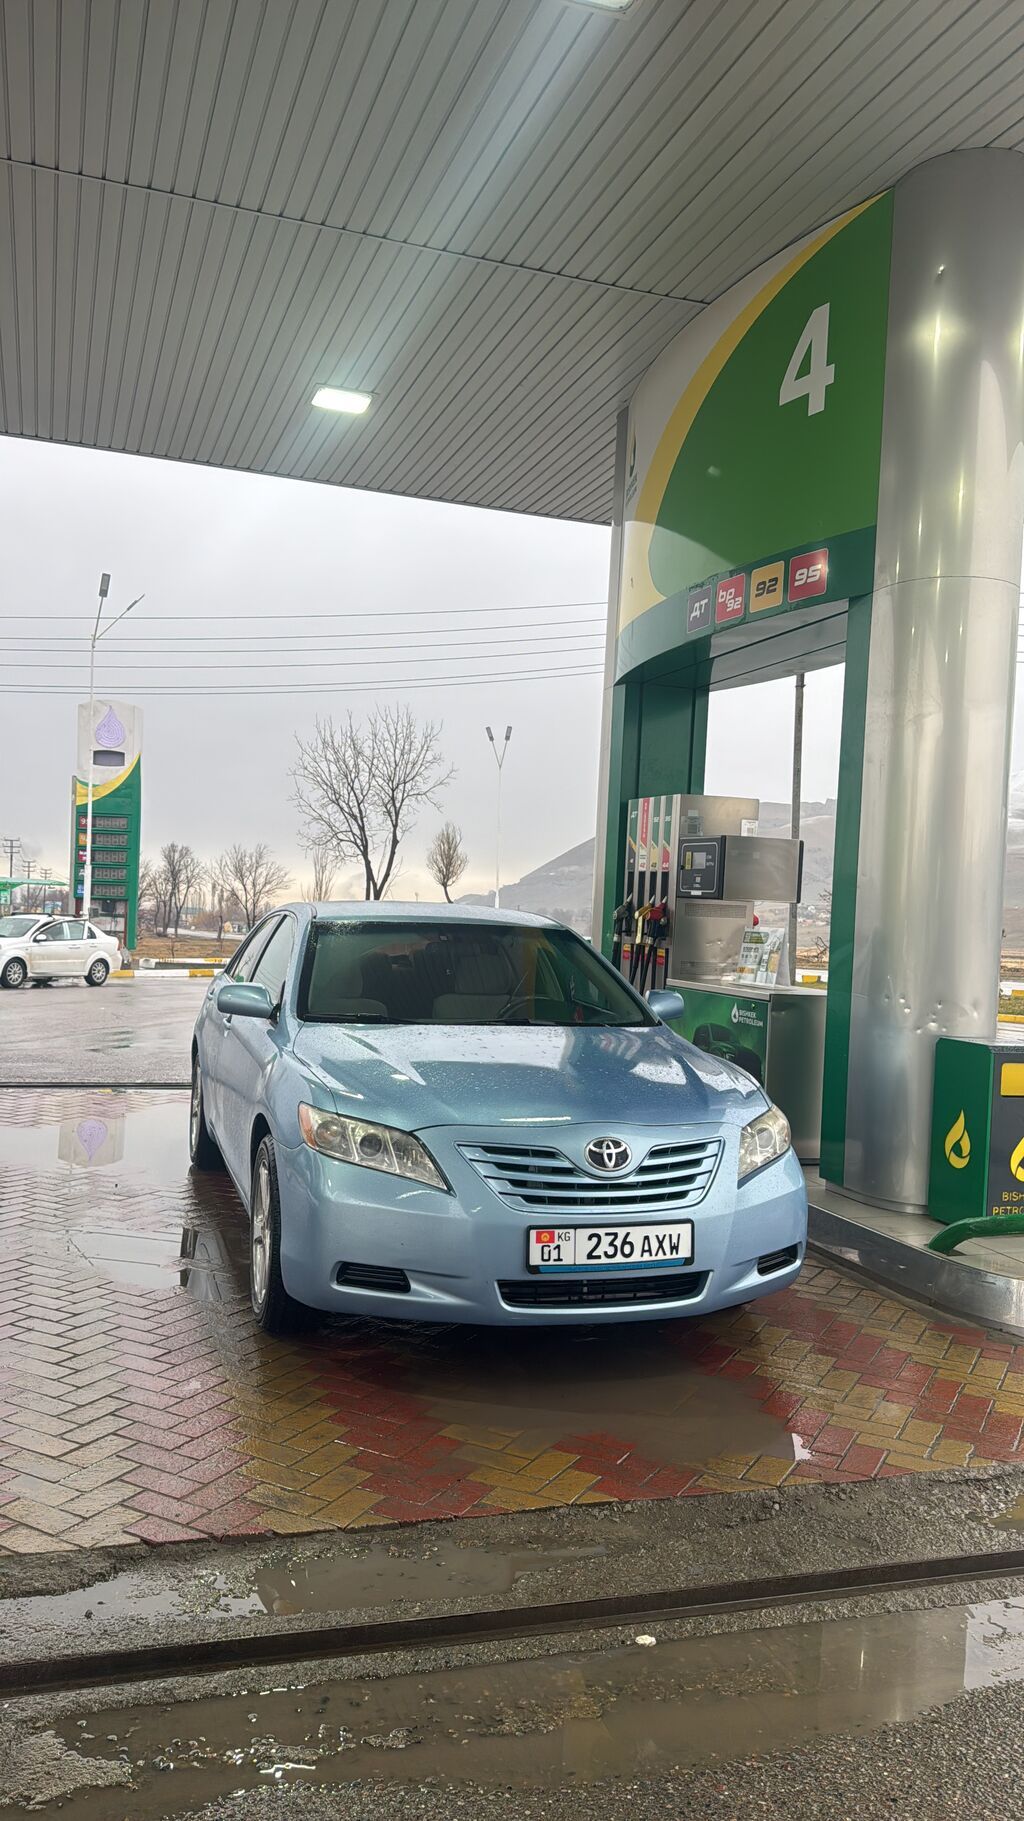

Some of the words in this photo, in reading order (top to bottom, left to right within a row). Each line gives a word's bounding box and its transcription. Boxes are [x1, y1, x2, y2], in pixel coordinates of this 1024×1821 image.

[779, 302, 835, 417] 4
[794, 563, 822, 587] 95
[754, 576, 778, 598] 92
[689, 598, 708, 621] ДТ
[726, 596, 742, 612] 92
[738, 1009, 757, 1019] BISHKEK
[738, 1016, 764, 1028] PETROLEUM
[557, 1231, 571, 1242] KG
[586, 1231, 635, 1260] 236
[640, 1233, 681, 1258] AXW
[540, 1244, 563, 1262] 01
